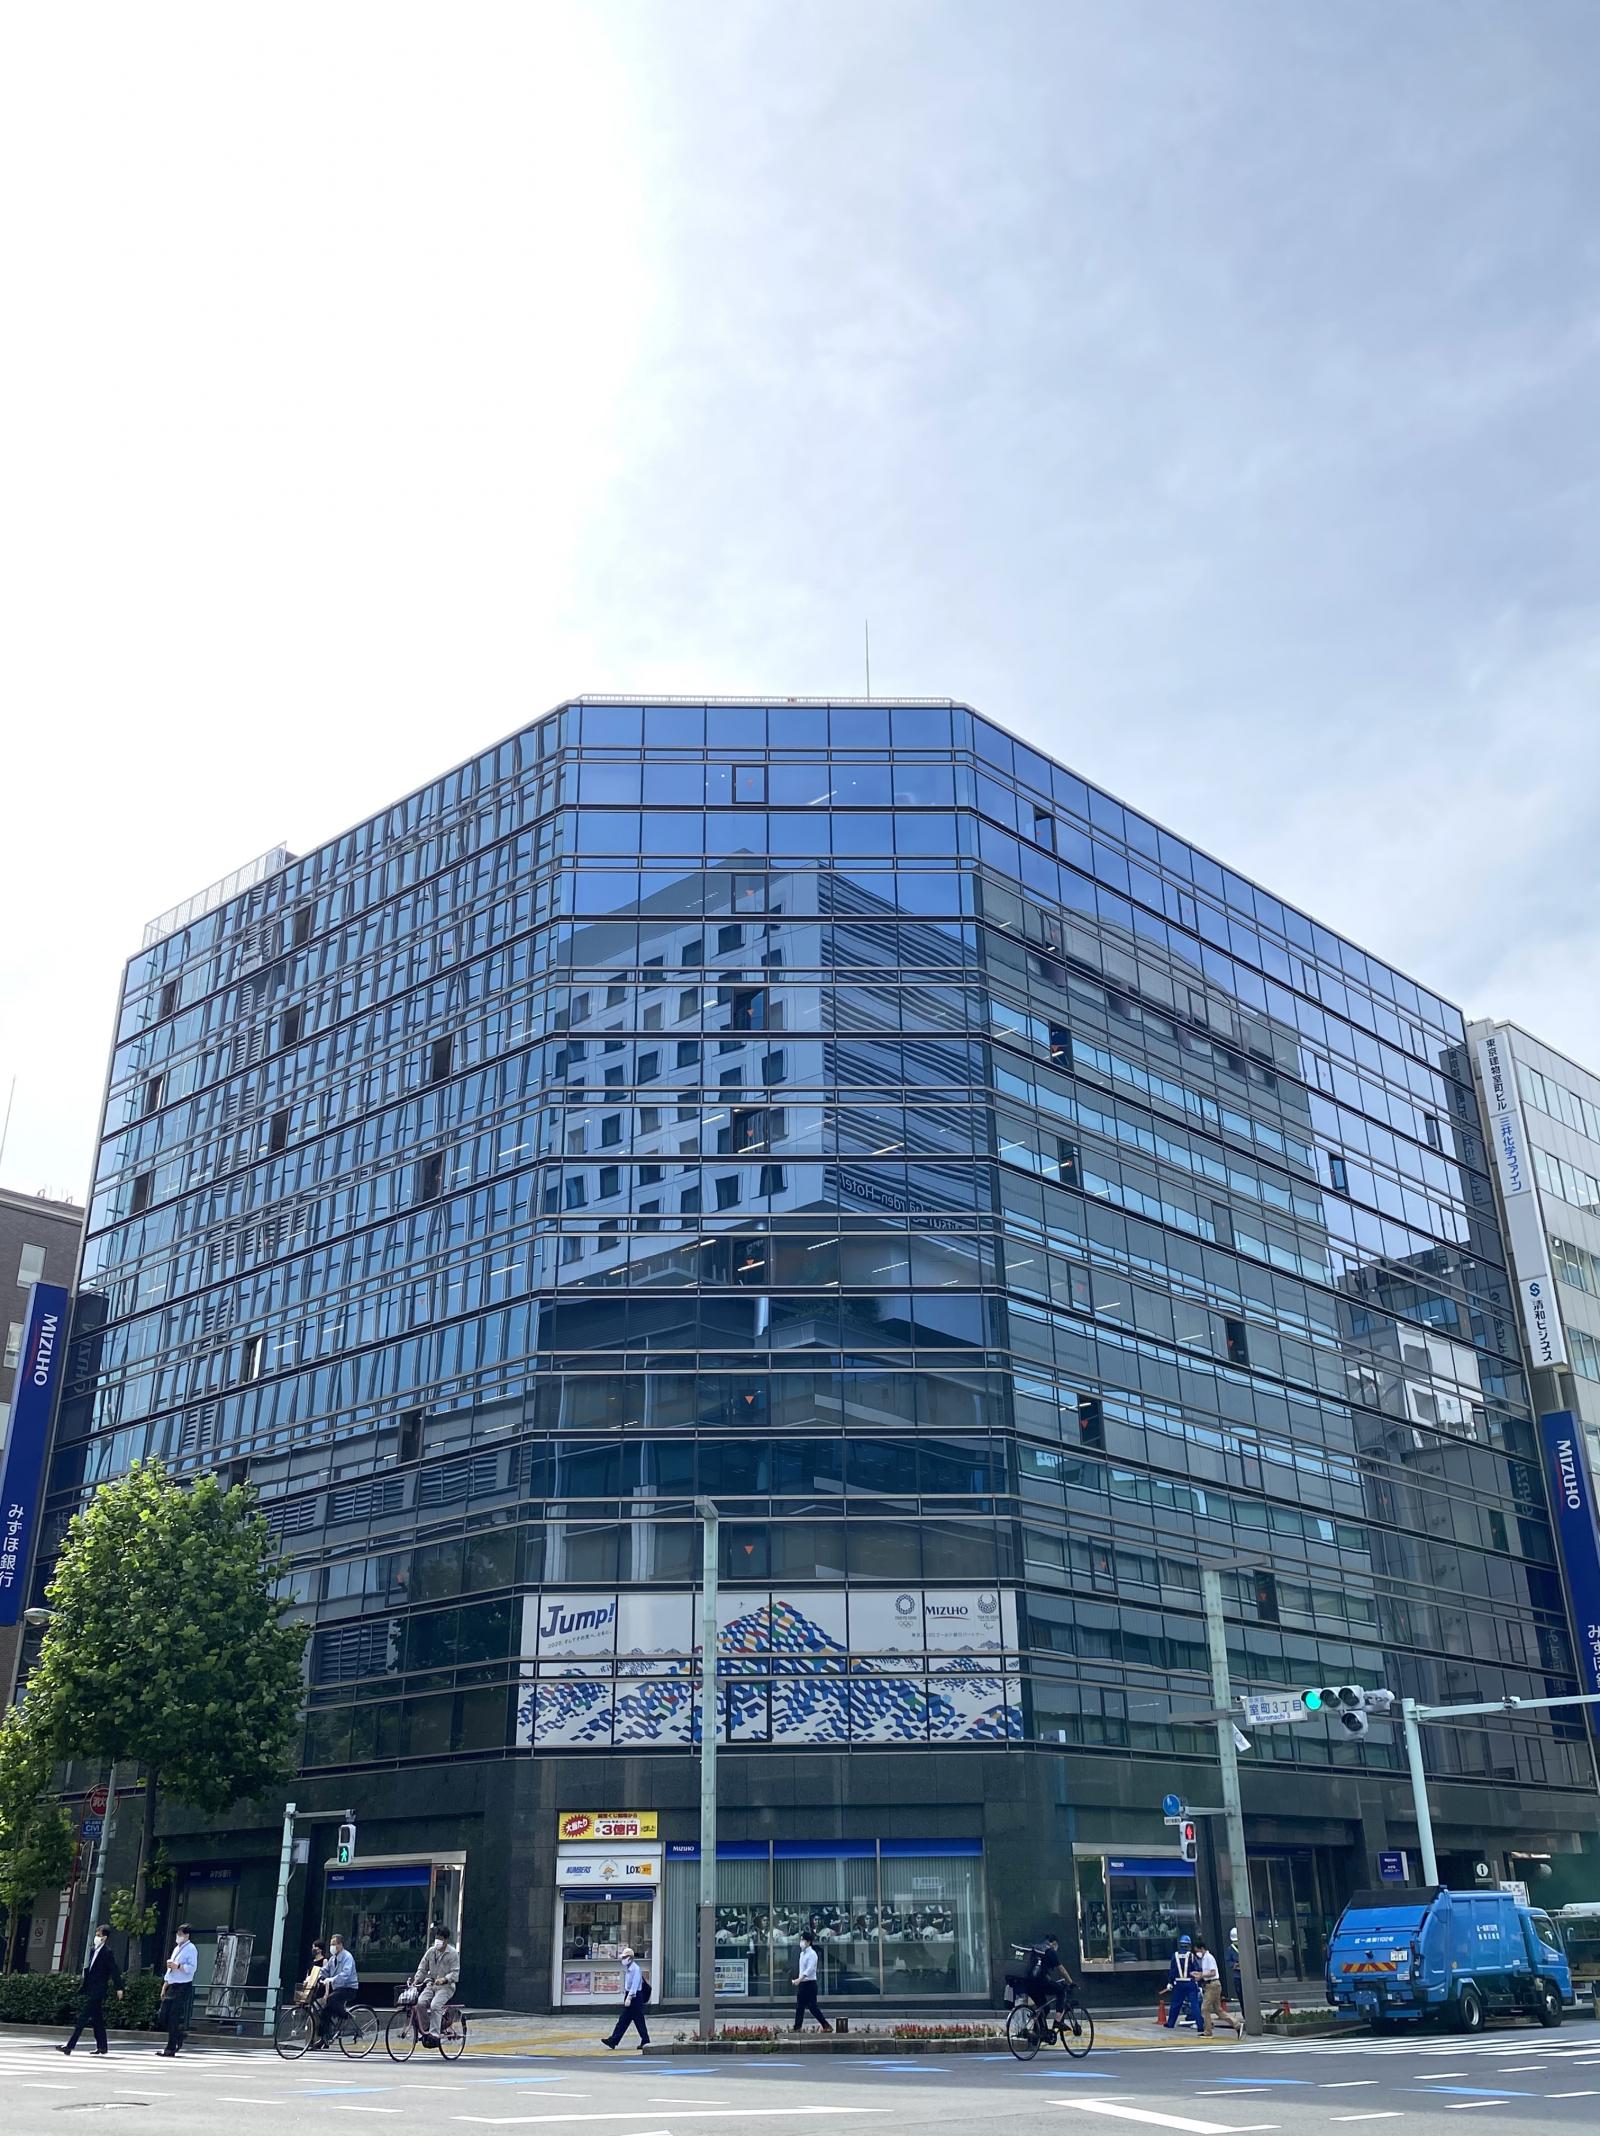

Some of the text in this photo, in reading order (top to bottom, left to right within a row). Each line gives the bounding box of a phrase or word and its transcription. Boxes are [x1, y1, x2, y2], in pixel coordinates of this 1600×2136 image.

[1485, 1038, 1508, 1112] 東京建物室町ビル
[33, 1312, 58, 1386] MIZUHO
[1556, 1438, 1581, 1510] MIZUHO
[0, 1503, 24, 1588] みずほ銀行
[540, 1603, 616, 1638] Jump!
[925, 1606, 969, 1615] MIZUHO
[1249, 1699, 1302, 1716] 室町3丁目
[1255, 1712, 1286, 1721] Muromachi
[602, 1824, 638, 1836] 3億円
